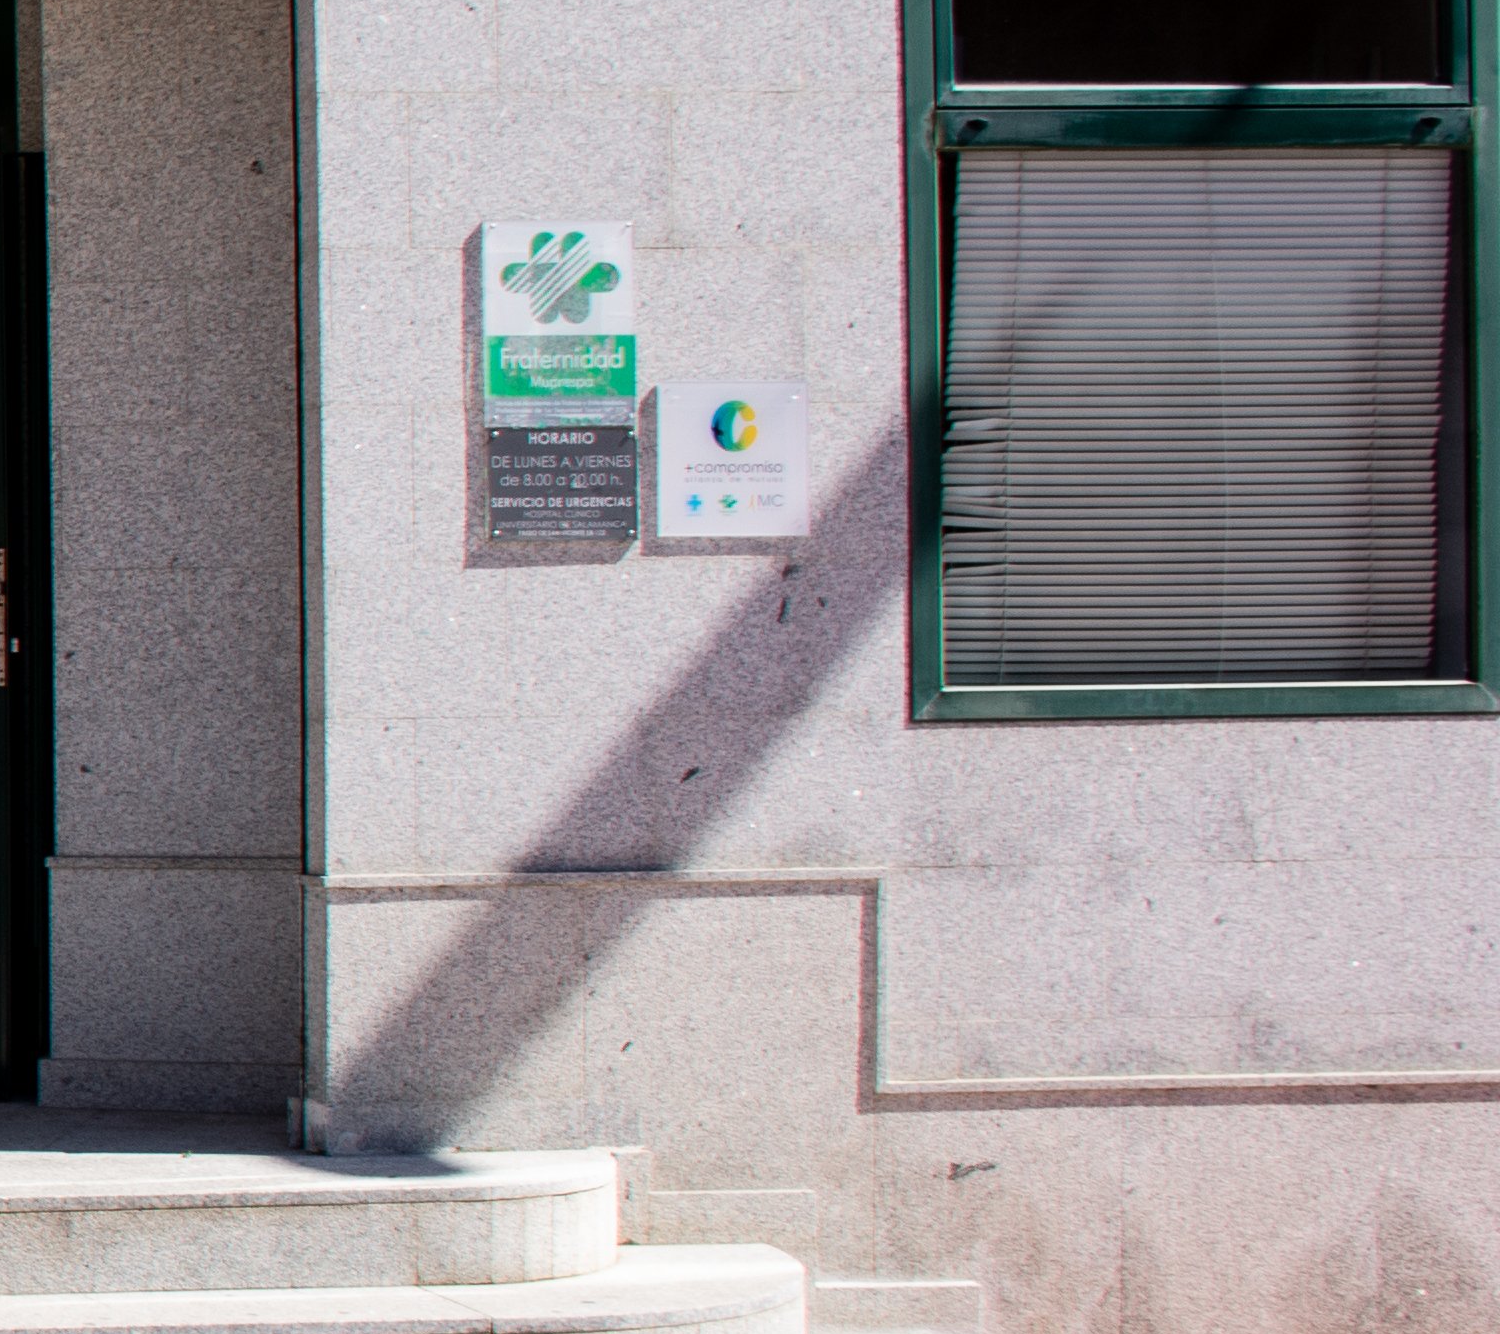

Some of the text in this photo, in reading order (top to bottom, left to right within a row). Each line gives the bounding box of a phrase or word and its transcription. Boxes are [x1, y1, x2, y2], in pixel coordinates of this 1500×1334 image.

[501, 346, 625, 369] Fraternidad
[530, 376, 596, 389] Muprespa
[528, 432, 596, 445] HORARIO
[491, 454, 633, 468] DE LUNES A VIERNES
[500, 473, 519, 486] de
[522, 473, 552, 486] 8.00
[555, 478, 566, 486] a
[491, 496, 633, 507] SERVICIO DE URGENCIAS
